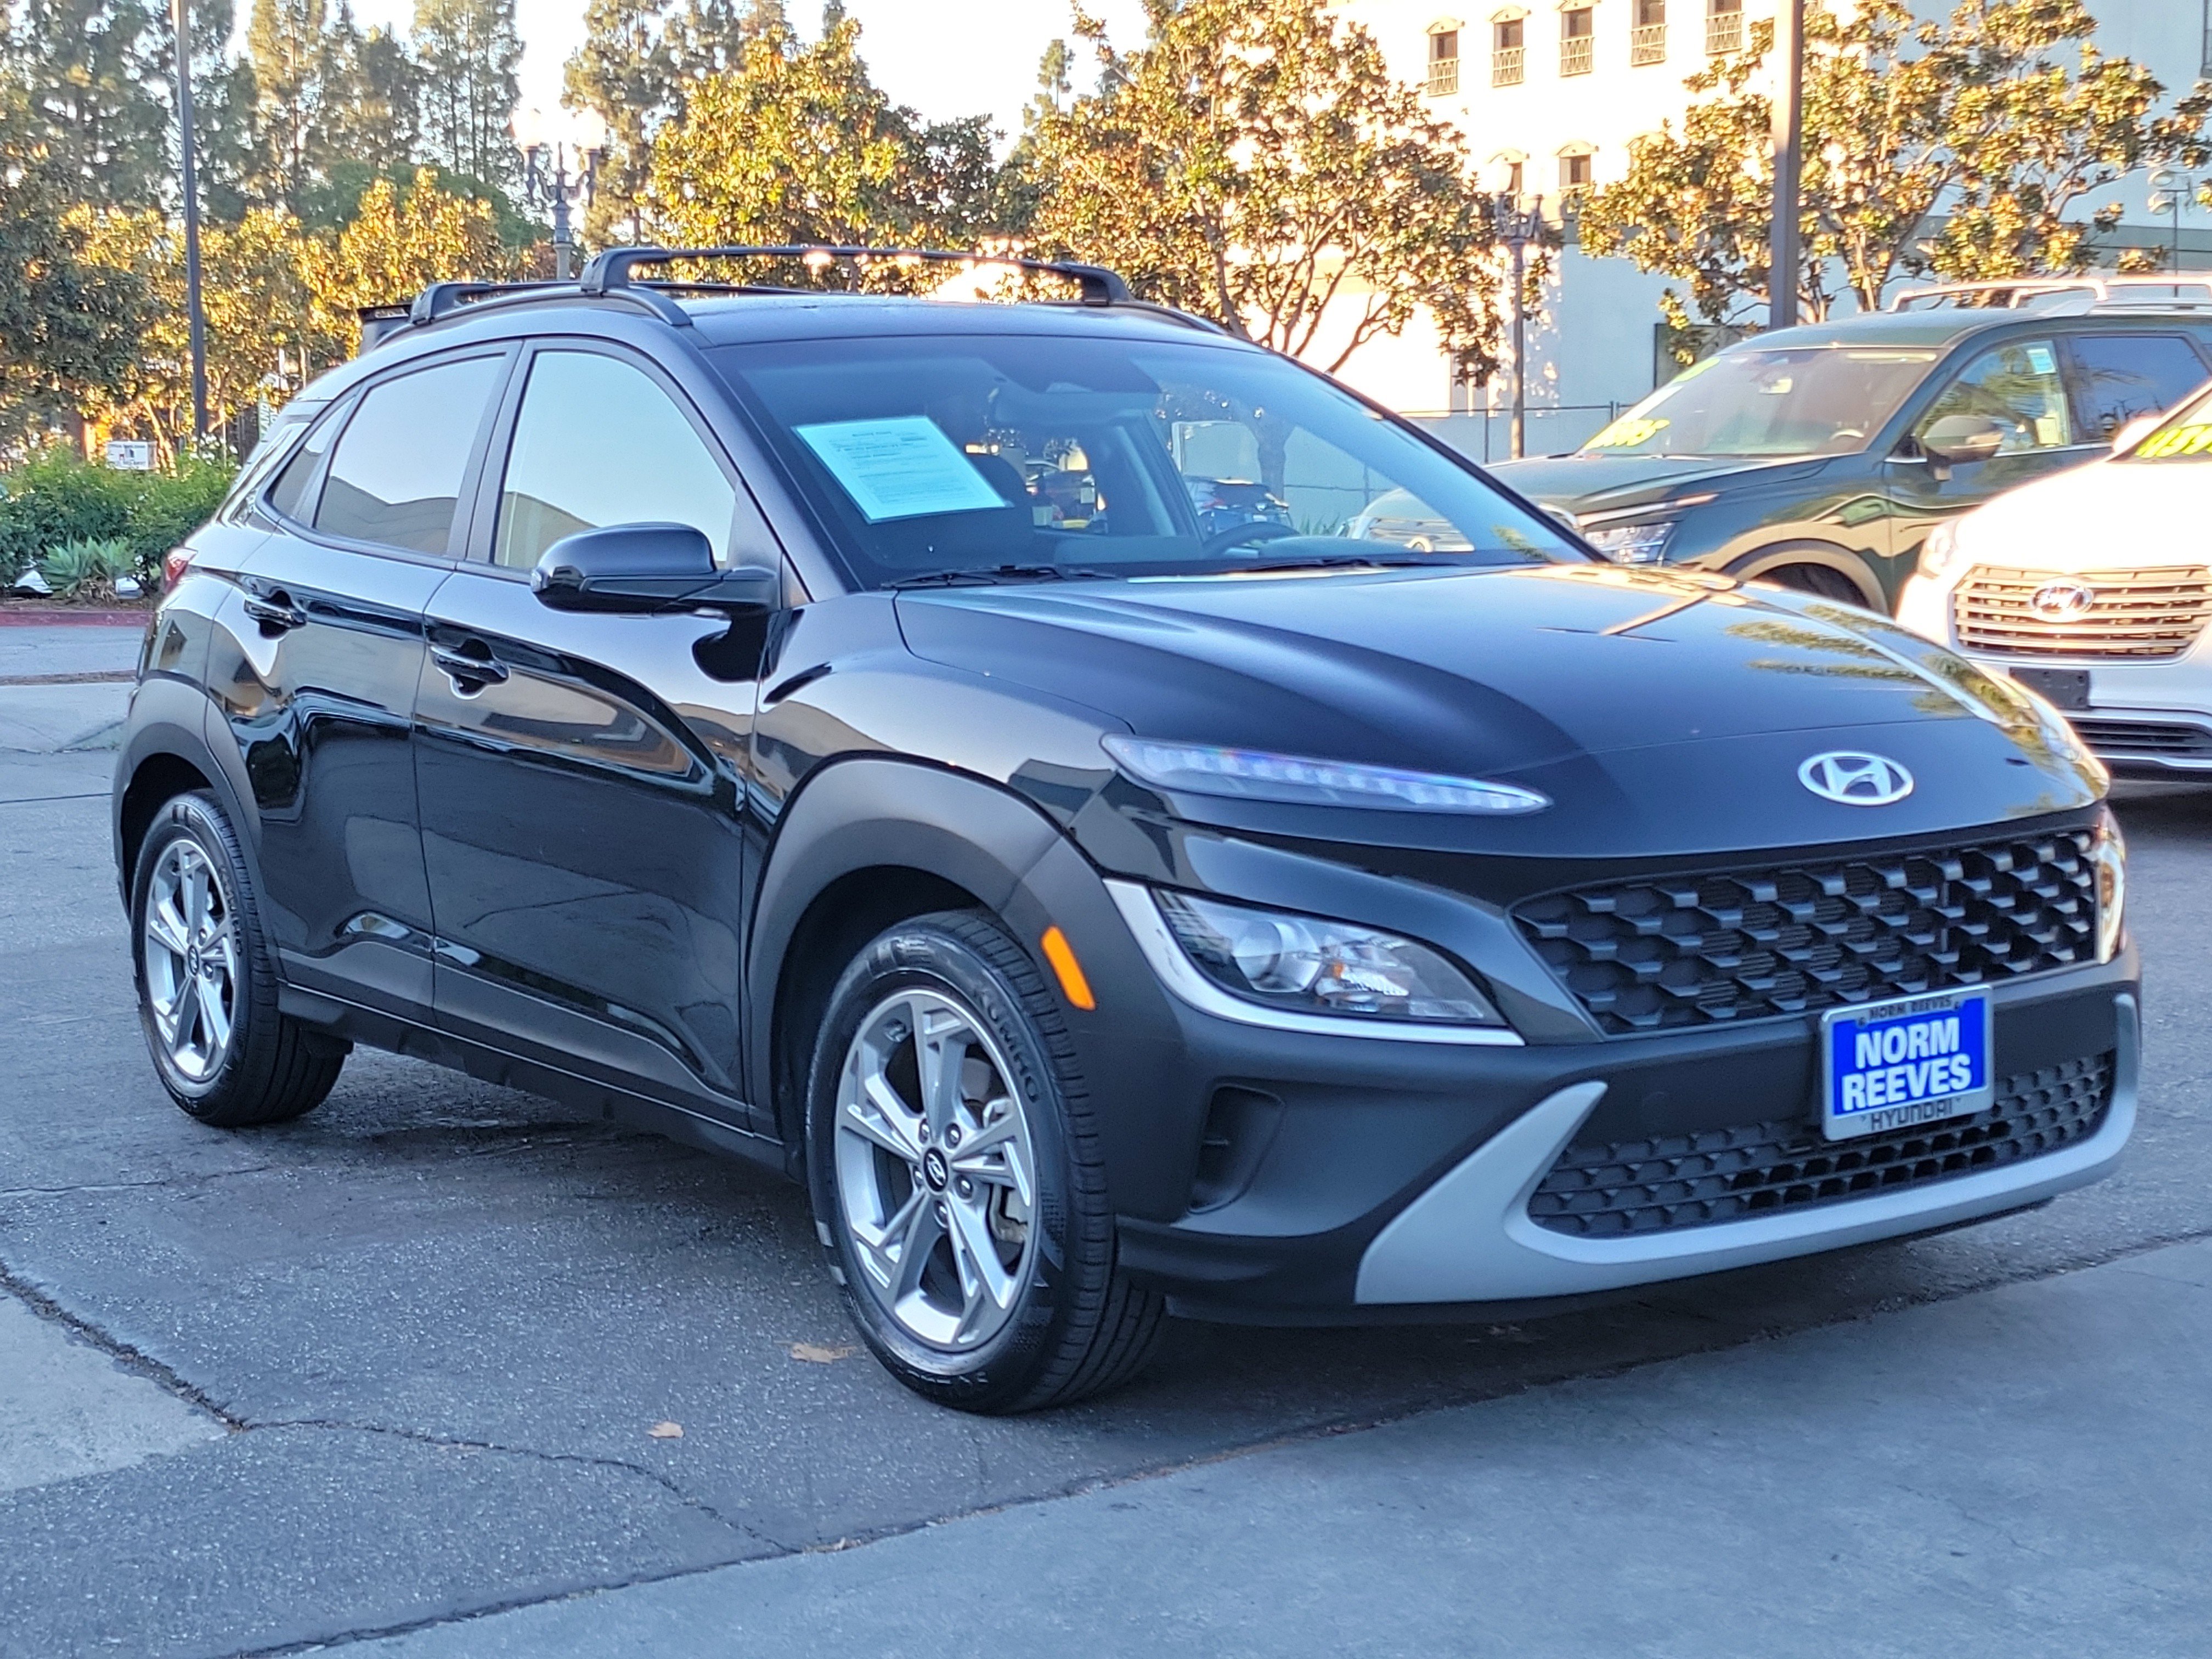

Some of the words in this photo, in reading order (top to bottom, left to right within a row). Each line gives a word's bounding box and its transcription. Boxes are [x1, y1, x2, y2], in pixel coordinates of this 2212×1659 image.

[1855, 1017, 1960, 1069] NORM
[1841, 1053, 1972, 1111] REEVES
[1871, 1099, 1954, 1131] HYUNDAI
